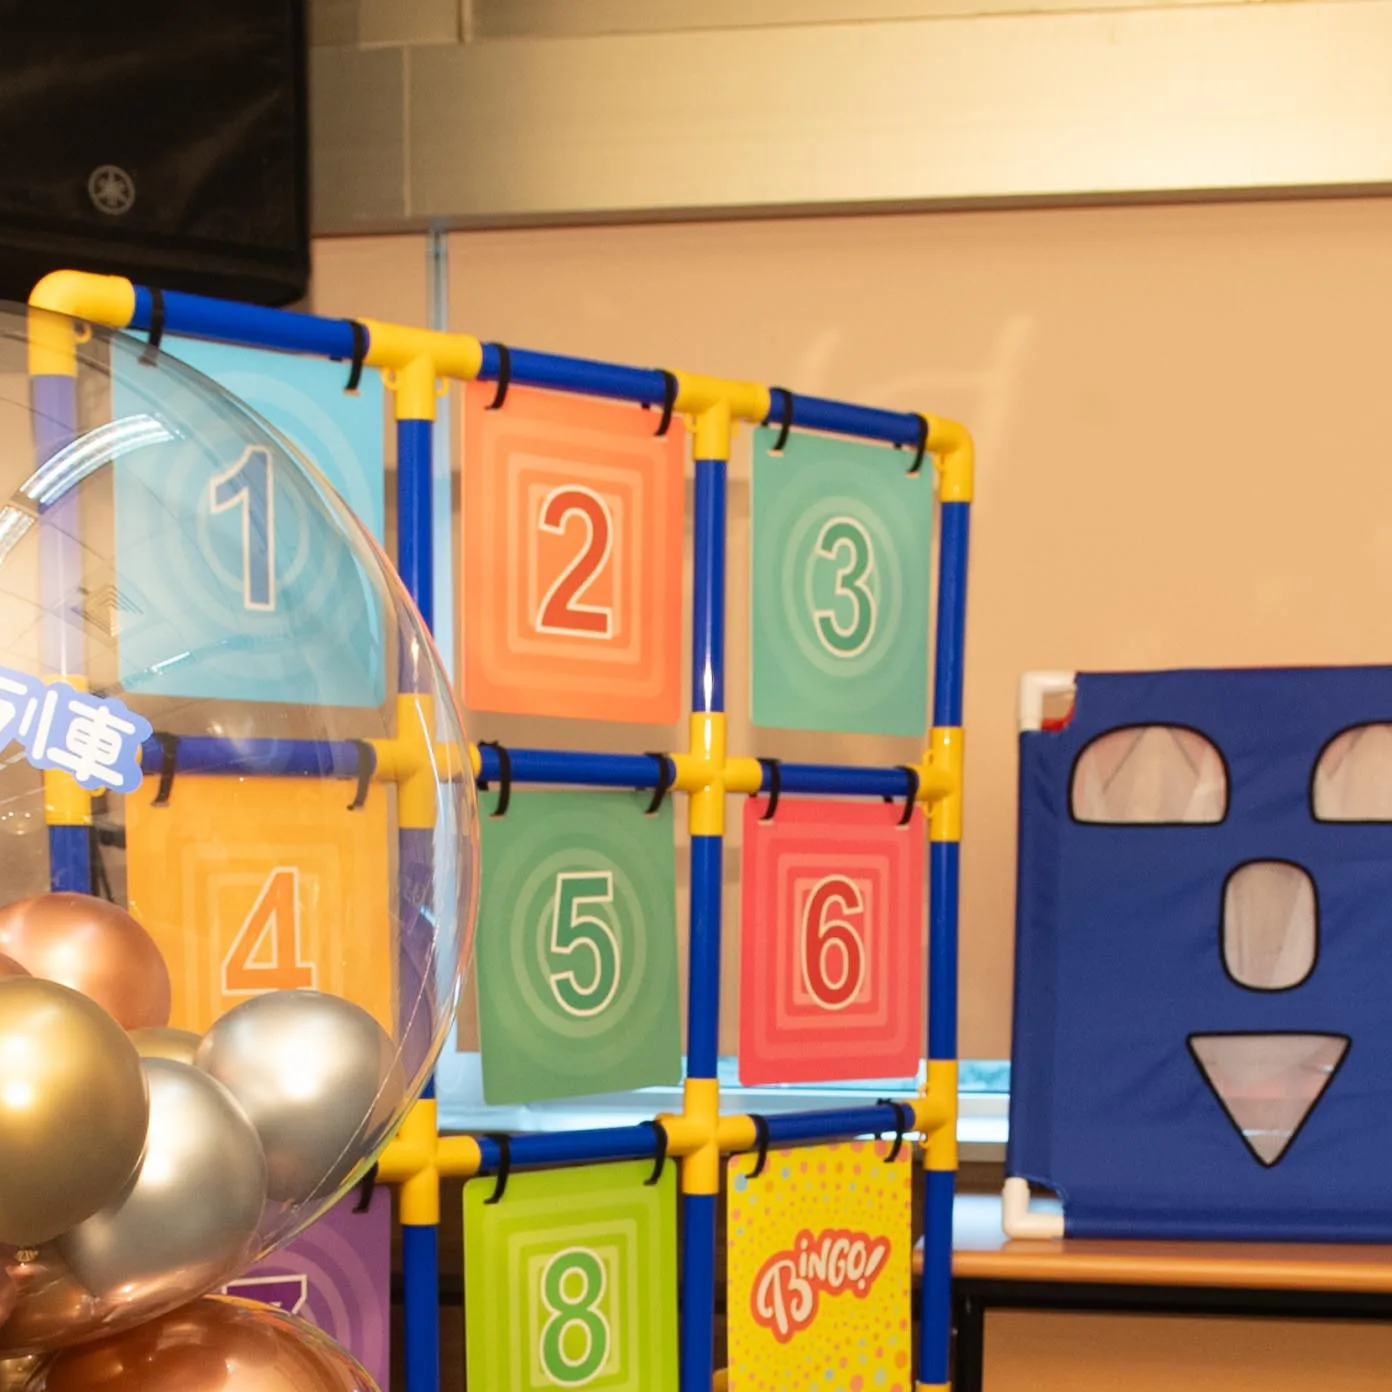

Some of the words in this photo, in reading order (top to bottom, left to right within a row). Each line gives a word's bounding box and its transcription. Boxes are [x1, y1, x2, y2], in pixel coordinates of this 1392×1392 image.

[210, 445, 276, 611] 1
[536, 485, 613, 639] 2
[812, 516, 876, 657] 3
[221, 866, 318, 996] 4
[549, 871, 620, 1017] 5
[801, 874, 865, 1011] 6
[539, 1246, 611, 1388] 8
